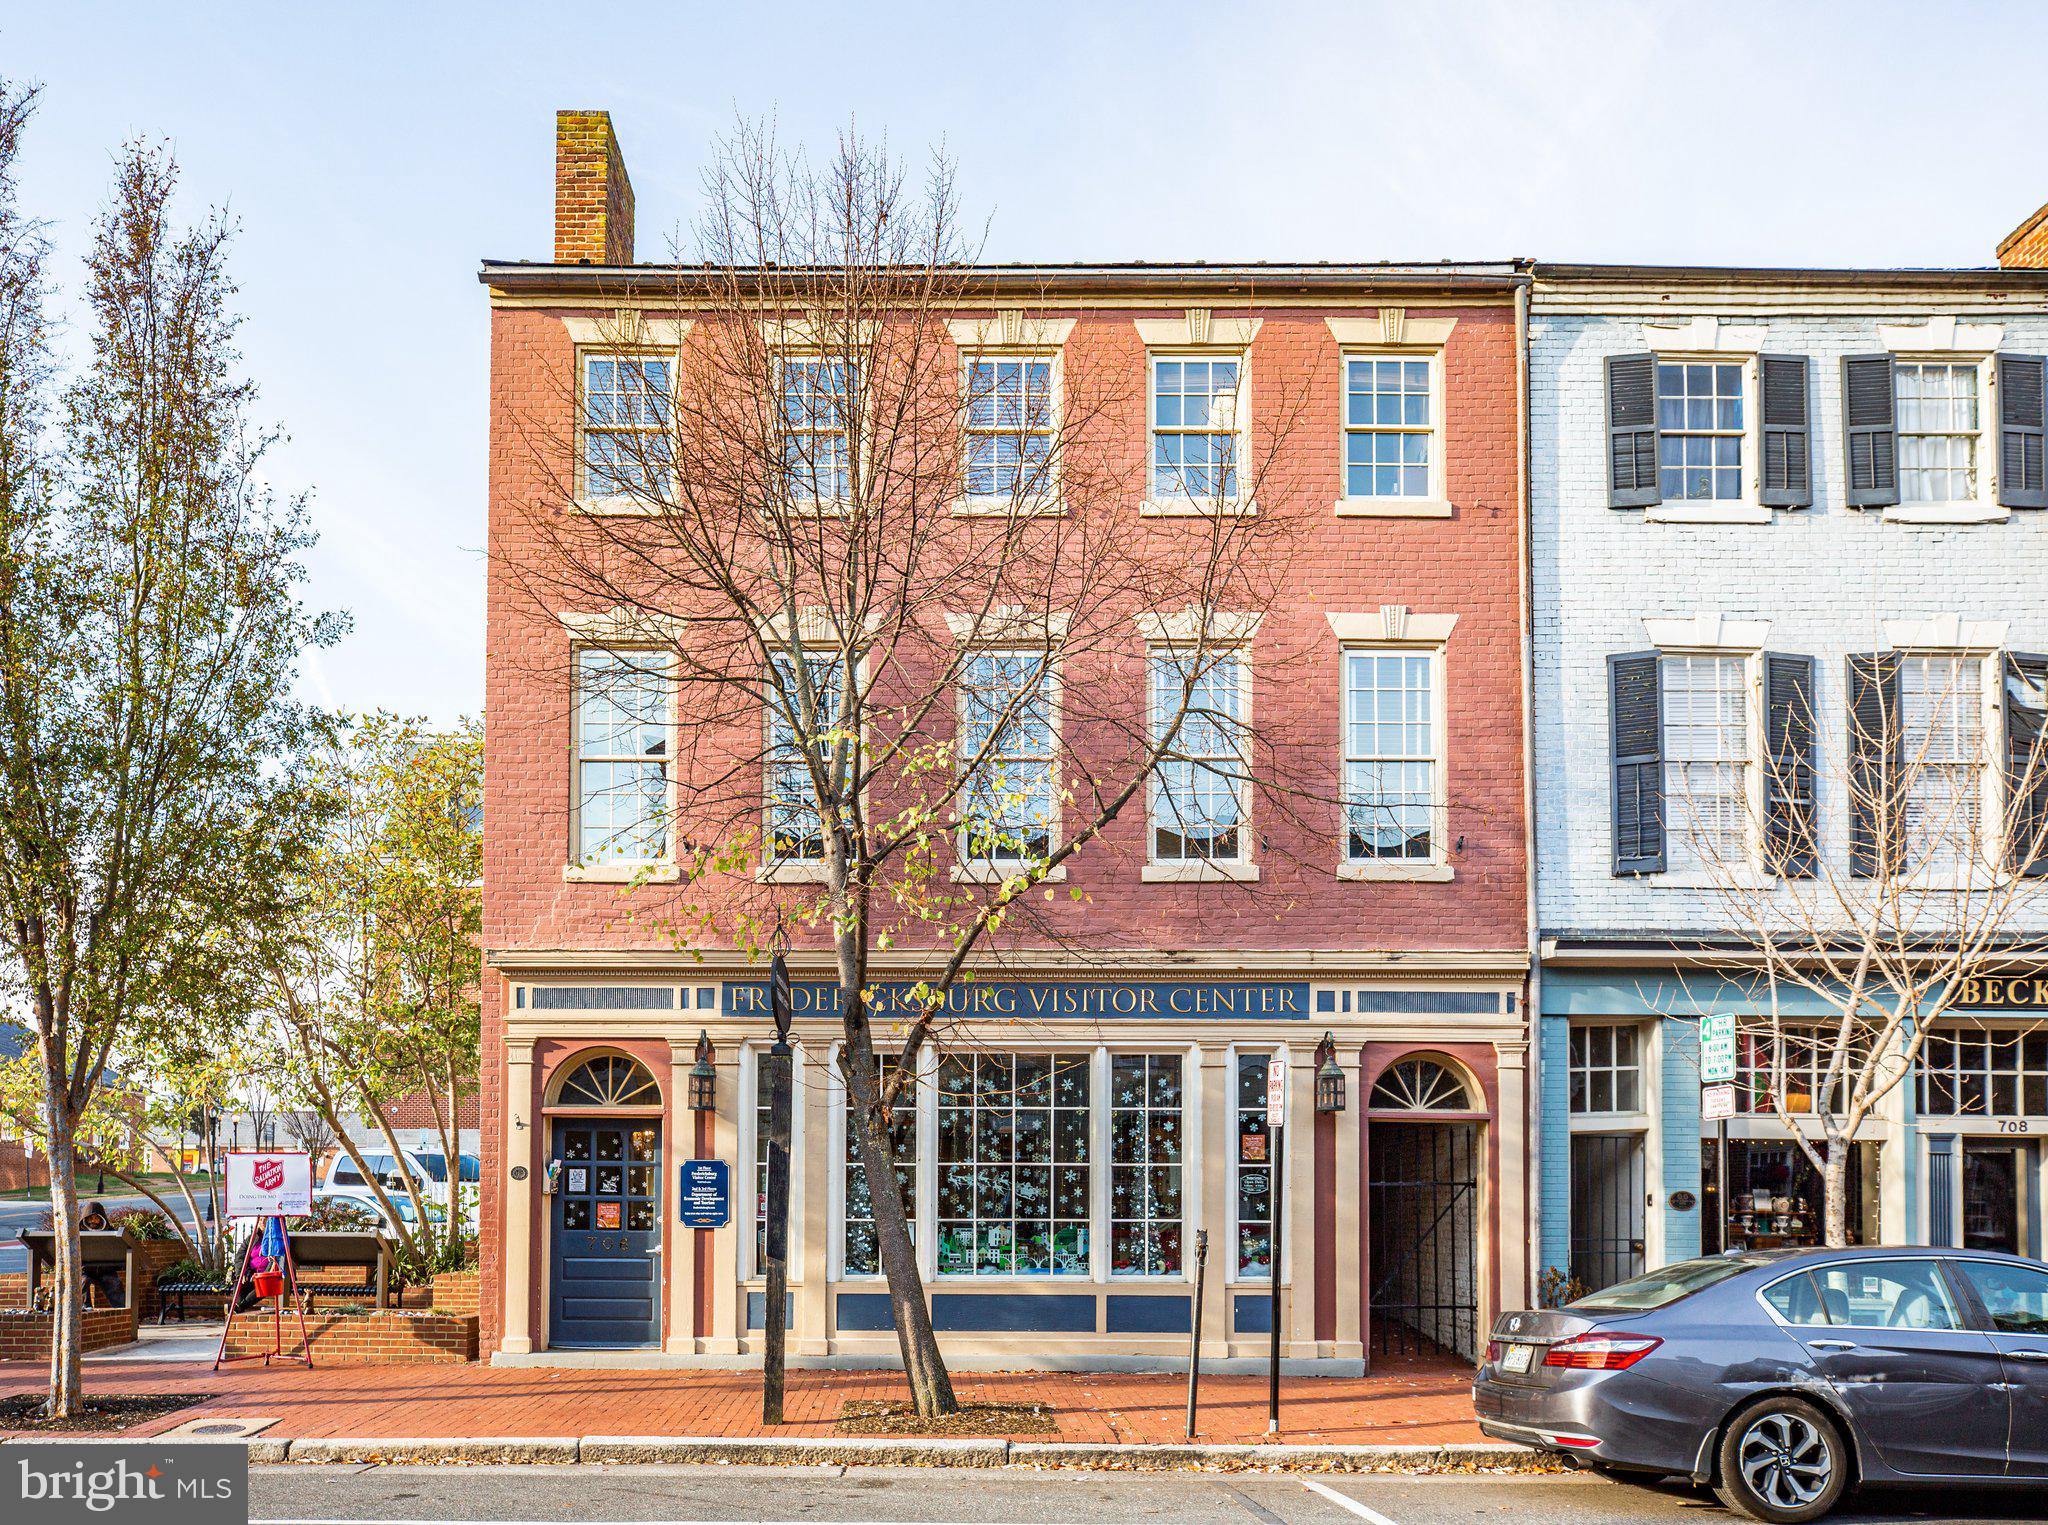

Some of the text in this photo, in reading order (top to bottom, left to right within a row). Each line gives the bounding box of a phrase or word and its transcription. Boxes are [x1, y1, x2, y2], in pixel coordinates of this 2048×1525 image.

[731, 987, 1301, 1013] FRDECKSURG VISITOR CENTER
[1712, 1027, 1733, 1036] PARKING
[1273, 1065, 1280, 1077] NO
[1269, 1079, 1283, 1091] PARKING
[1998, 1120, 2028, 1133] 708
[258, 1161, 272, 1173] THE
[254, 1163, 282, 1184] SALVATION
[264, 1173, 281, 1189] ARMY
